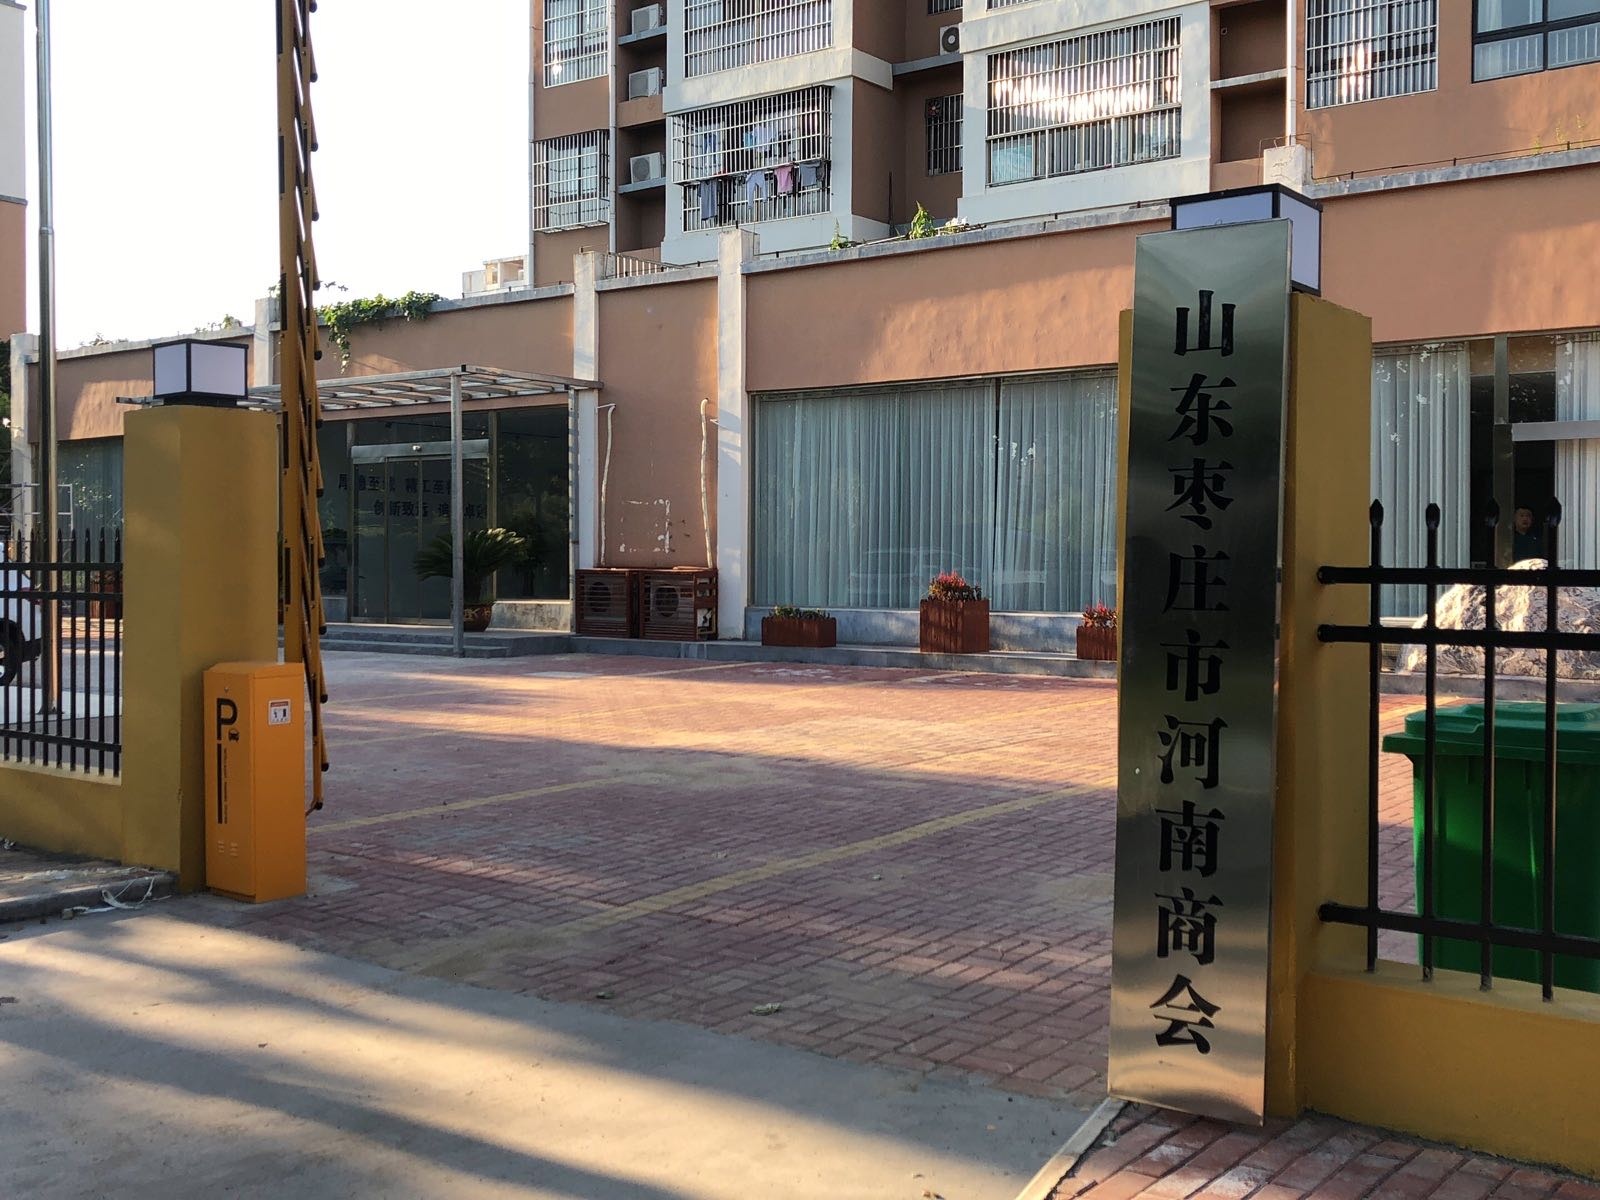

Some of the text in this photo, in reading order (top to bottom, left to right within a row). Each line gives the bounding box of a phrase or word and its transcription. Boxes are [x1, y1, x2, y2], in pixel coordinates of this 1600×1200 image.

[217, 698, 239, 741] P
[1149, 289, 1236, 1055] 山东枣庄市河南商会
